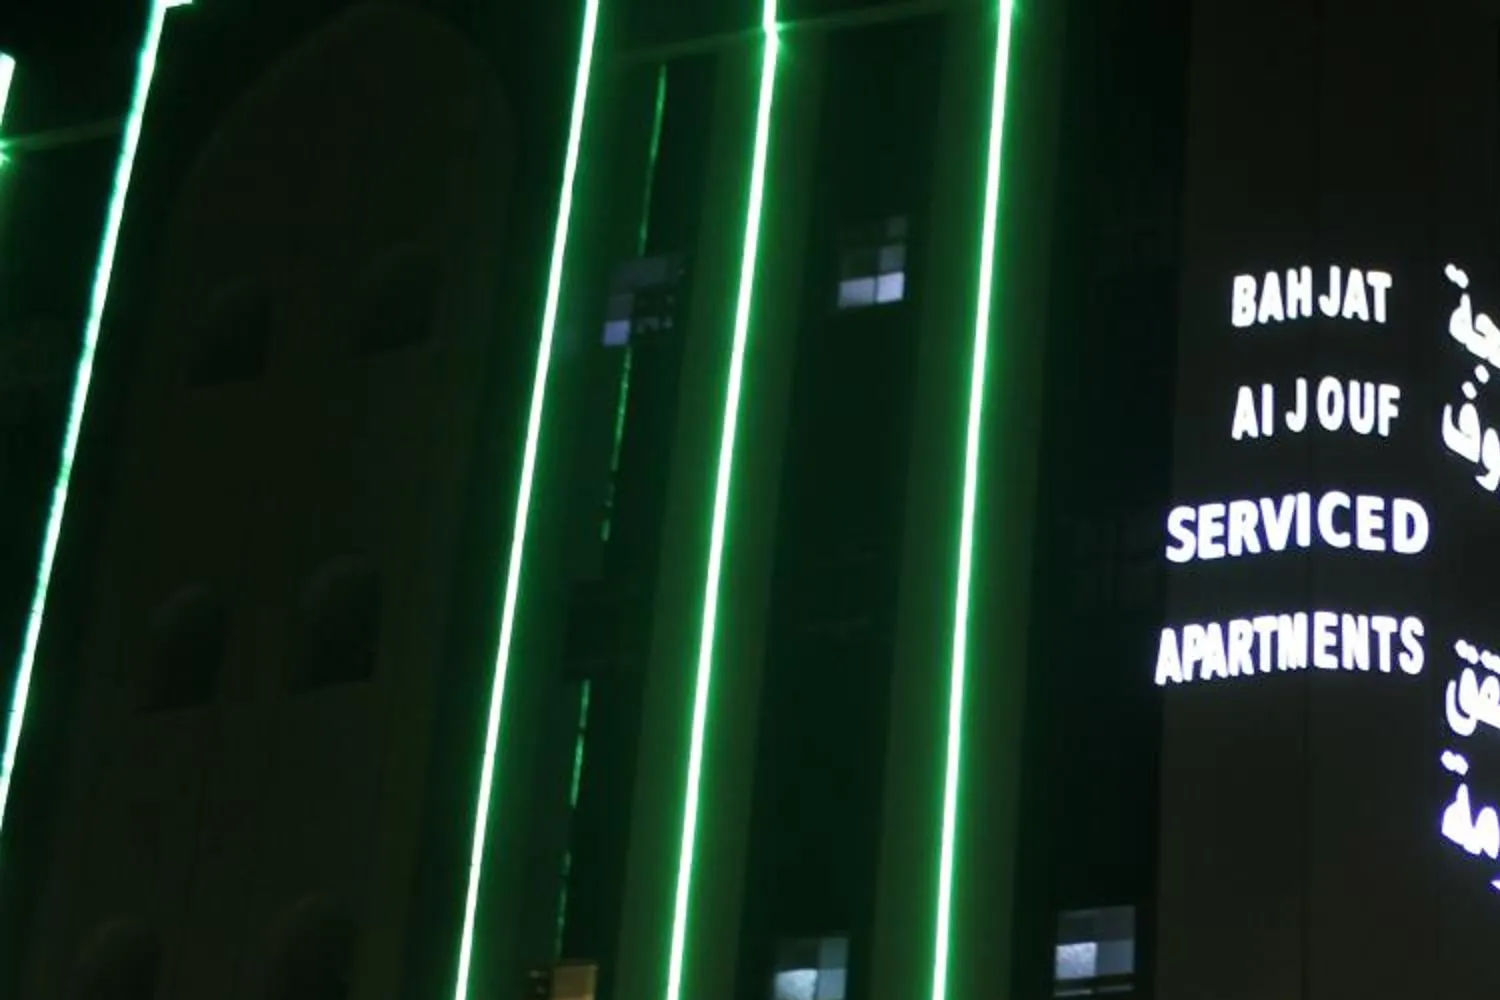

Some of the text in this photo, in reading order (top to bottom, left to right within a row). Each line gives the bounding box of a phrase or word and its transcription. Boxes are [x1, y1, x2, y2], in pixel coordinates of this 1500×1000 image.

[1232, 266, 1392, 327] BAHJAT
[1166, 491, 1428, 562] SERVICED
[1155, 611, 1424, 685] APARTMENTS
